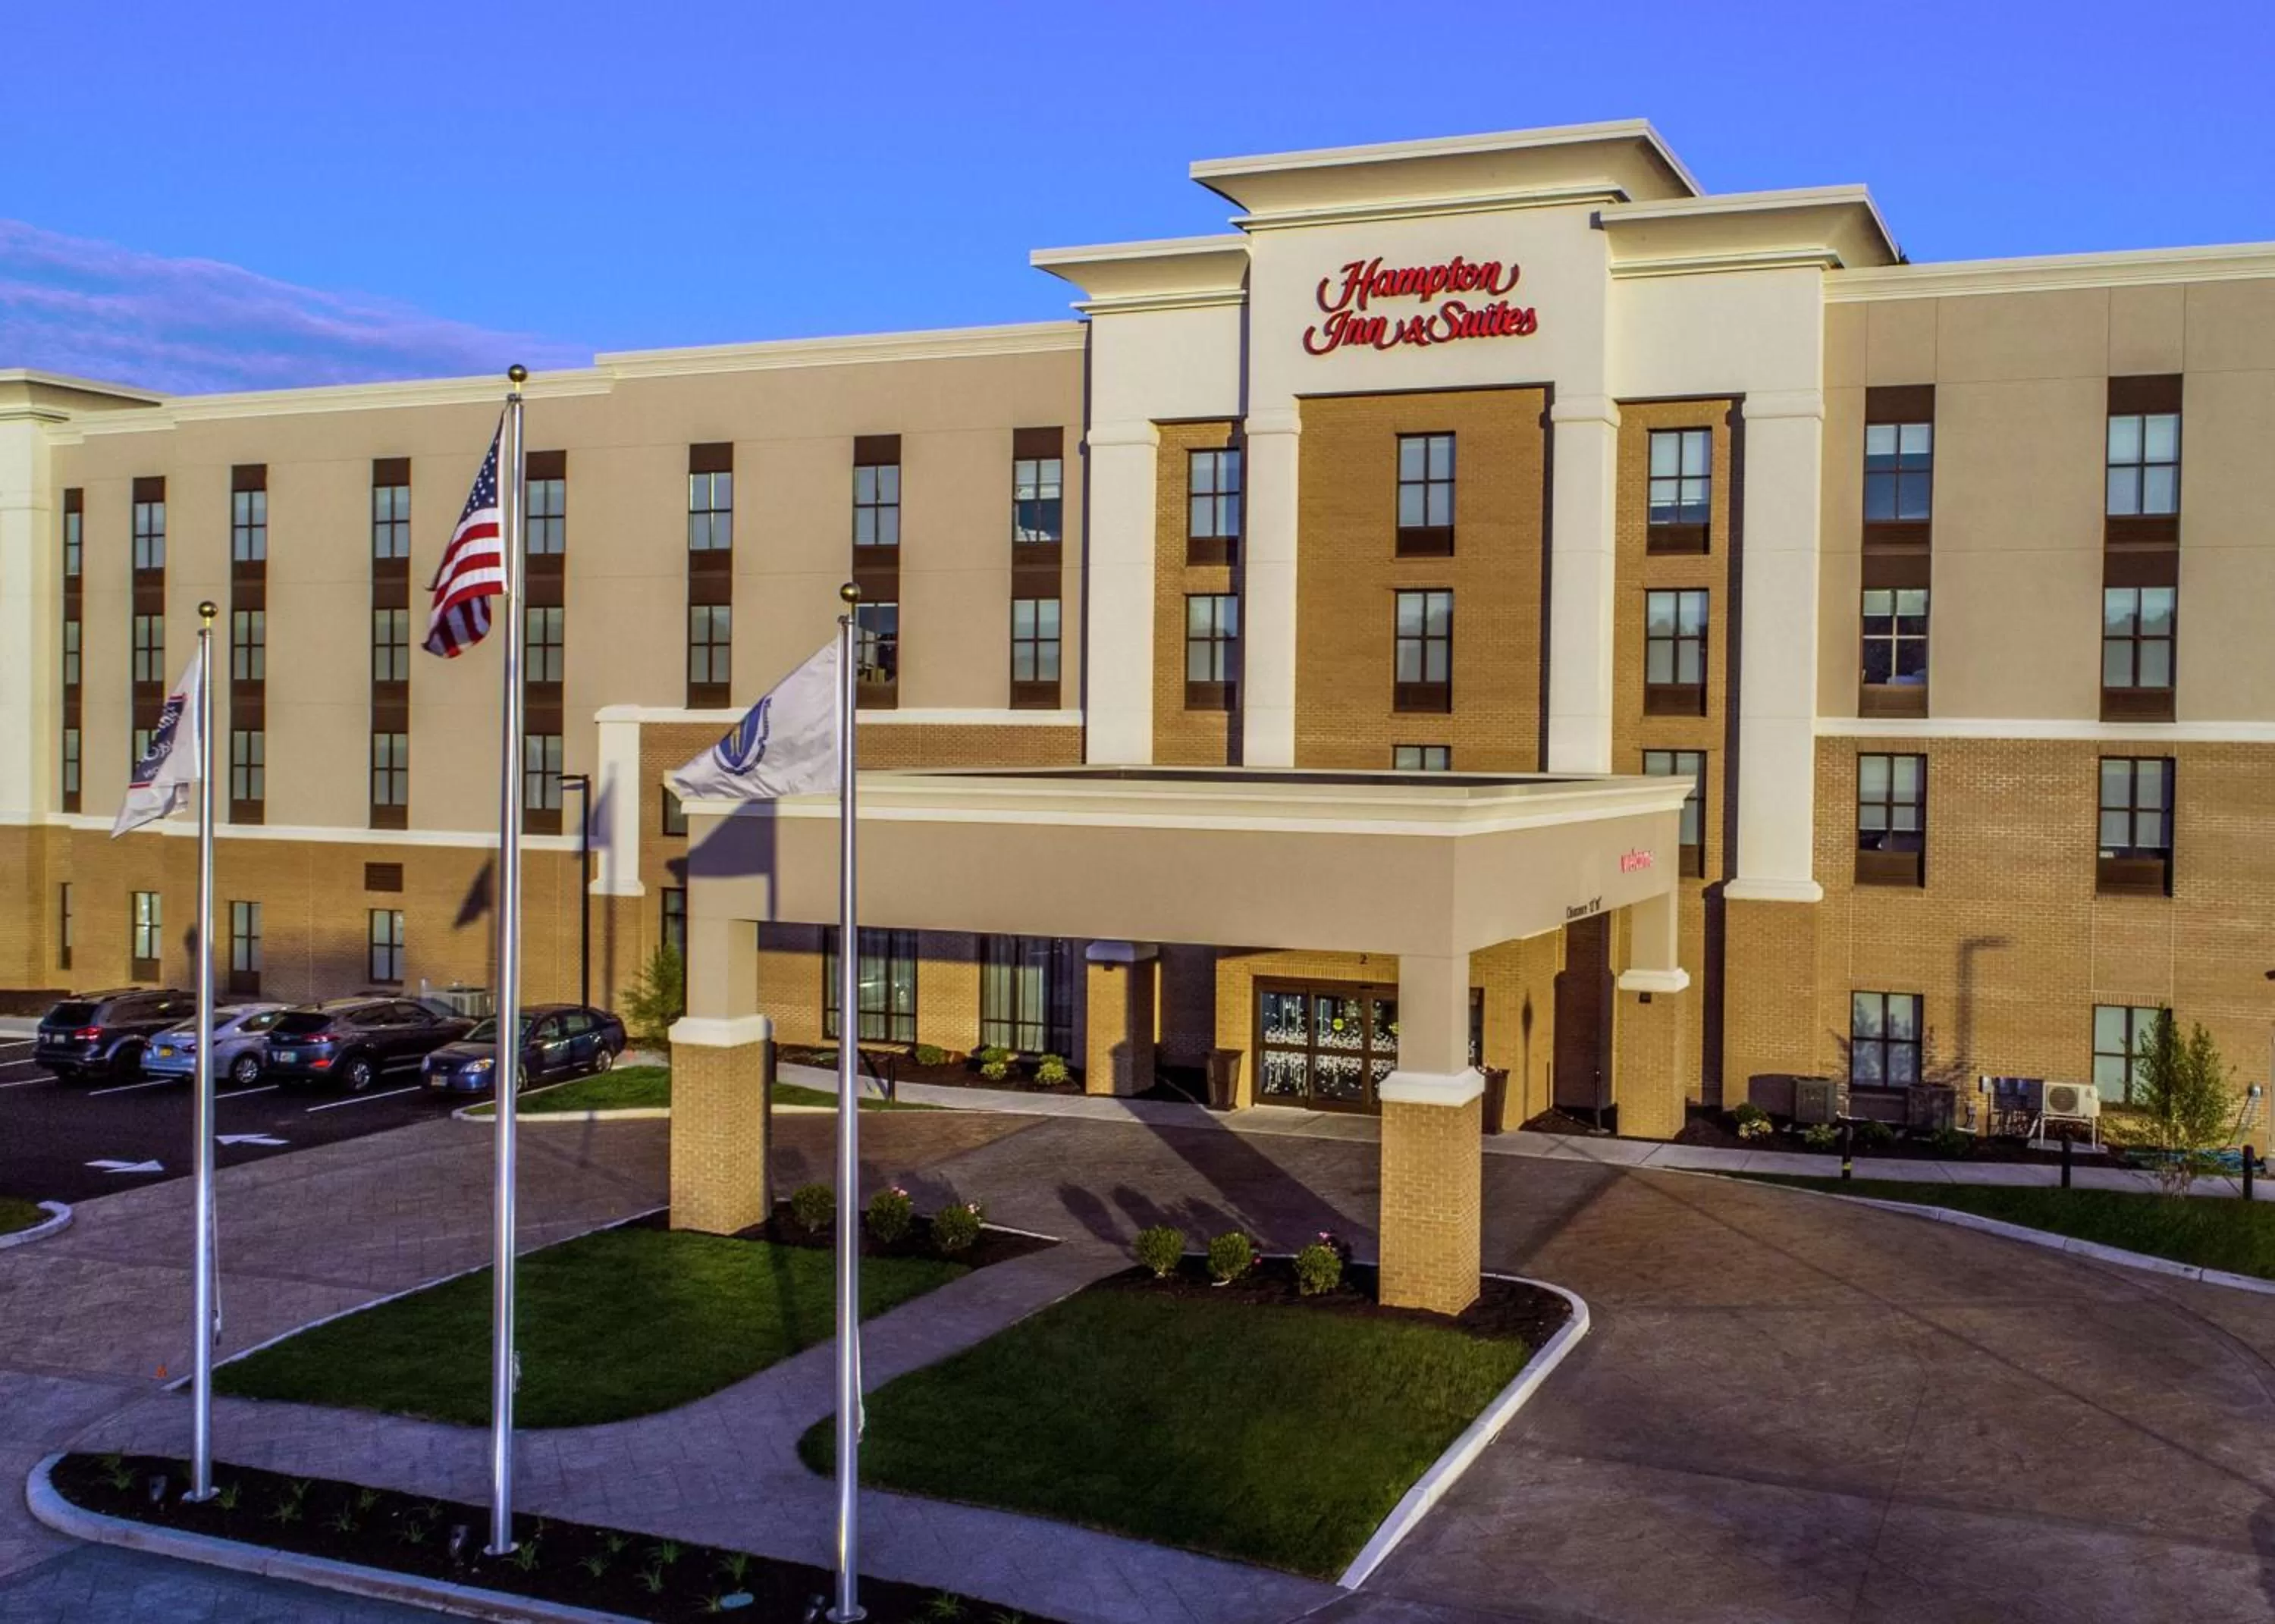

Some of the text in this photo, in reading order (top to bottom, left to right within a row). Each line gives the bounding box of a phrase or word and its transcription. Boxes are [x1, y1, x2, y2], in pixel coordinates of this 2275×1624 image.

[1316, 256, 1520, 312] Hampton
[1303, 300, 1538, 355] Inn & Suites
